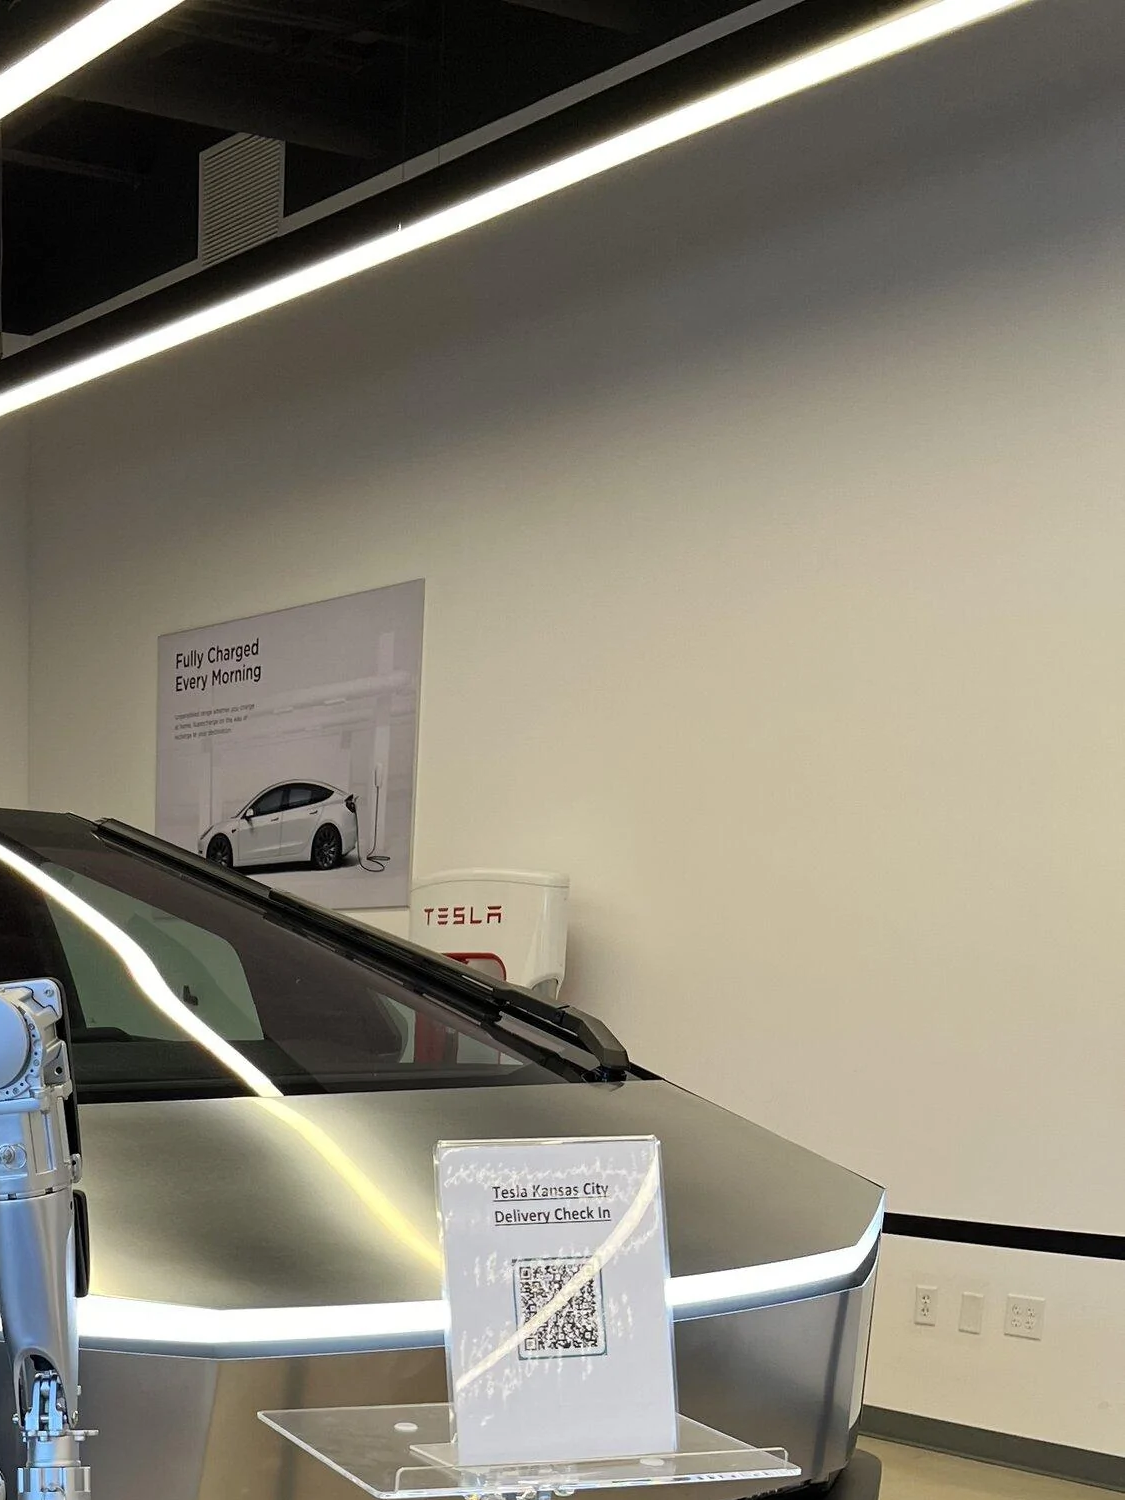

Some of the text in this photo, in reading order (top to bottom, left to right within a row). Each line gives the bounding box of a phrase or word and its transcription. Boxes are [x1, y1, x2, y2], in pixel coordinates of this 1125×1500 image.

[176, 638, 259, 669] Fully Charged
[175, 664, 261, 692] Every Morning
[424, 905, 502, 926] TESLA
[492, 1182, 609, 1199] Tesla Kansas City
[494, 1206, 611, 1224] Delivery Check In
